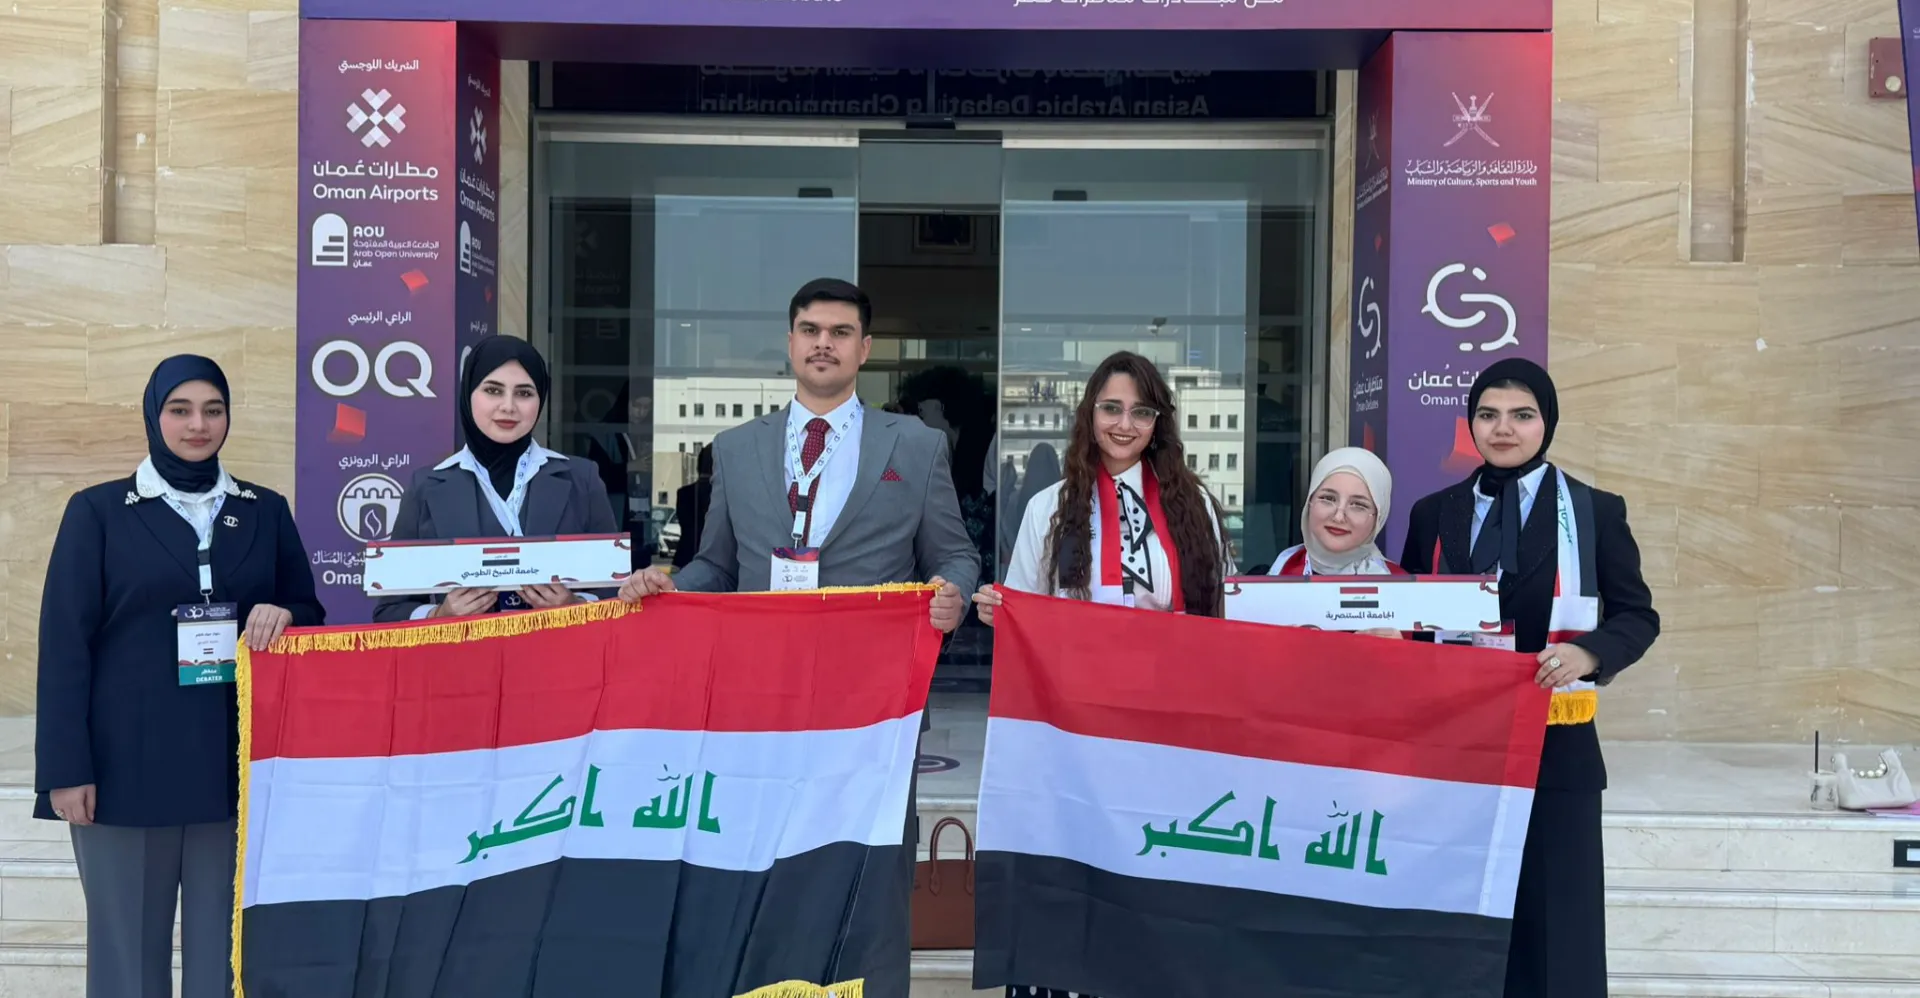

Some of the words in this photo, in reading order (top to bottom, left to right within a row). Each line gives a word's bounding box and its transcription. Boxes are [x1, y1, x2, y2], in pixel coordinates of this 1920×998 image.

[338, 58, 382, 74] اللوجستي
[384, 59, 419, 72] الشريك
[369, 160, 438, 179] مطارات
[1407, 177, 1438, 187] Ministry
[1438, 177, 1447, 186] of
[1447, 177, 1475, 187] Culture,
[1475, 177, 1499, 187] Sports
[1500, 177, 1514, 186] and
[1515, 177, 1537, 186] Youth
[313, 183, 365, 199] Oman
[370, 184, 439, 203] Airports
[353, 226, 385, 238] AOU
[353, 250, 373, 258] Arab
[374, 250, 397, 259] Open
[398, 250, 439, 260] University
[352, 259, 373, 269] عمان
[348, 310, 383, 326] الرئيسي
[385, 311, 412, 326] الراعي
[312, 340, 437, 398] OQ
[1420, 393, 1459, 406] Oman
[338, 453, 379, 470] البرونزي
[381, 453, 410, 471] الراعي
[322, 569, 362, 585] Oma
[461, 569, 491, 580] الطوسي
[492, 567, 514, 578] الشيخ
[515, 567, 540, 576] جامعة
[1325, 610, 1365, 621] المستنصرية
[1366, 611, 1394, 620] الجامعة
[196, 675, 222, 683] DEBATER
[632, 763, 721, 834] الله
[1304, 799, 1388, 876] الله
